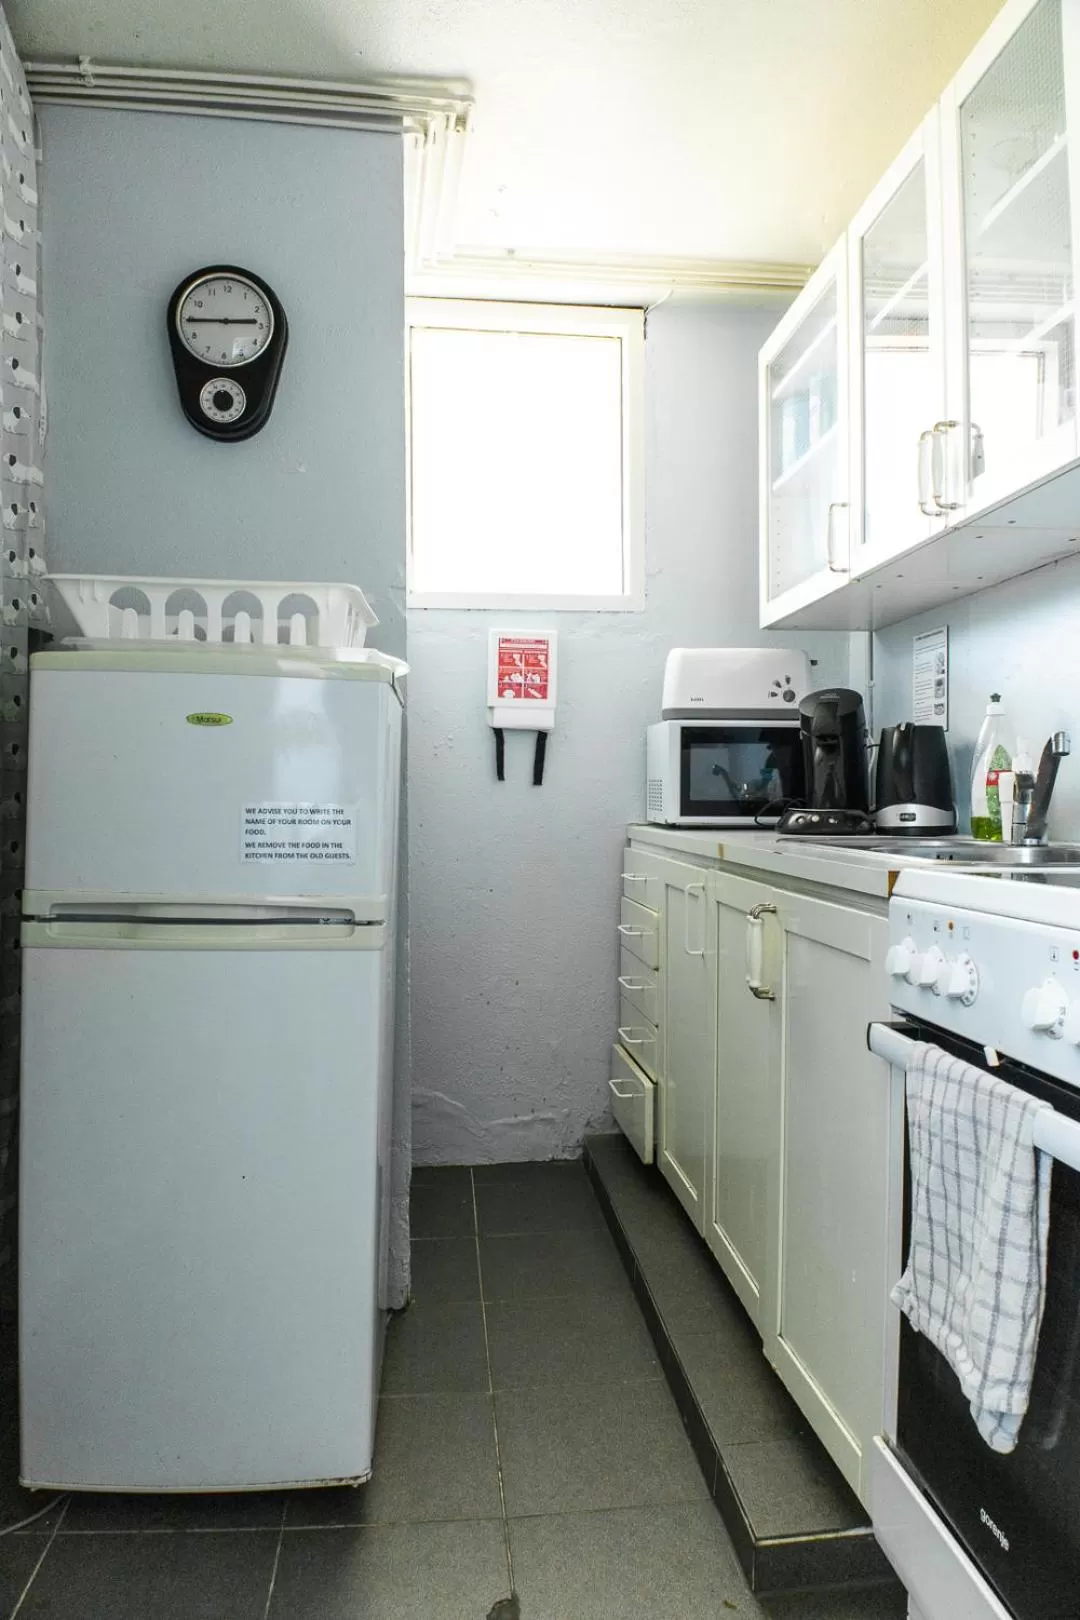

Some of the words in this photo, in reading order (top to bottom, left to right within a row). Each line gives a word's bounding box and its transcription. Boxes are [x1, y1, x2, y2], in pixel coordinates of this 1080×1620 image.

[208, 288, 216, 296] 11
[223, 285, 232, 293] 12
[243, 292, 247, 300] 1
[194, 300, 203, 308] 10
[980, 1508, 1010, 1551] gorenje
